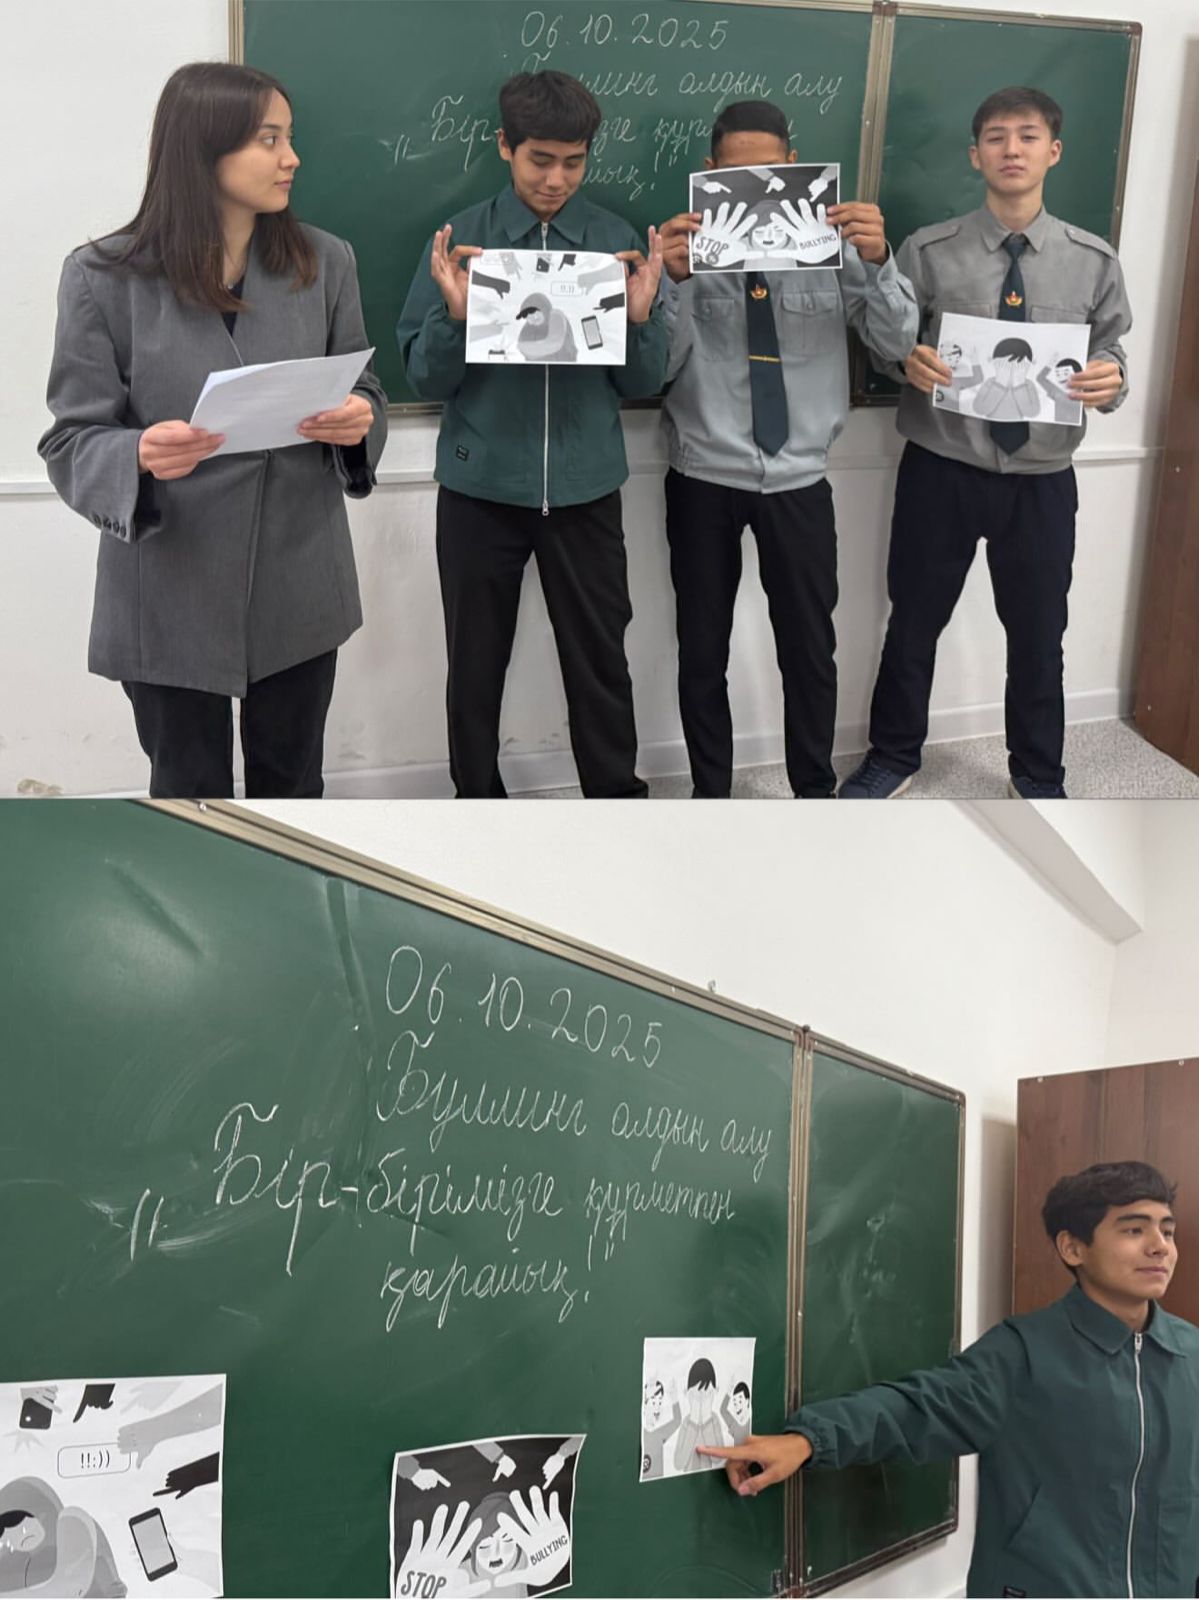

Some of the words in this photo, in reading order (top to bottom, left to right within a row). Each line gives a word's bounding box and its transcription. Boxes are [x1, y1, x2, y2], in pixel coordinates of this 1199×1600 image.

[521, 11, 729, 50] 06.10.2025
[679, 71, 772, 113] алдын
[784, 72, 843, 115] алу
[696, 236, 729, 256] STOP
[386, 945, 662, 1067] 06.10.2025
[611, 1102, 709, 1172] алдын
[720, 1119, 772, 1183] алу
[530, 1535, 568, 1565] BULLYING
[401, 1570, 447, 1598] STOP
